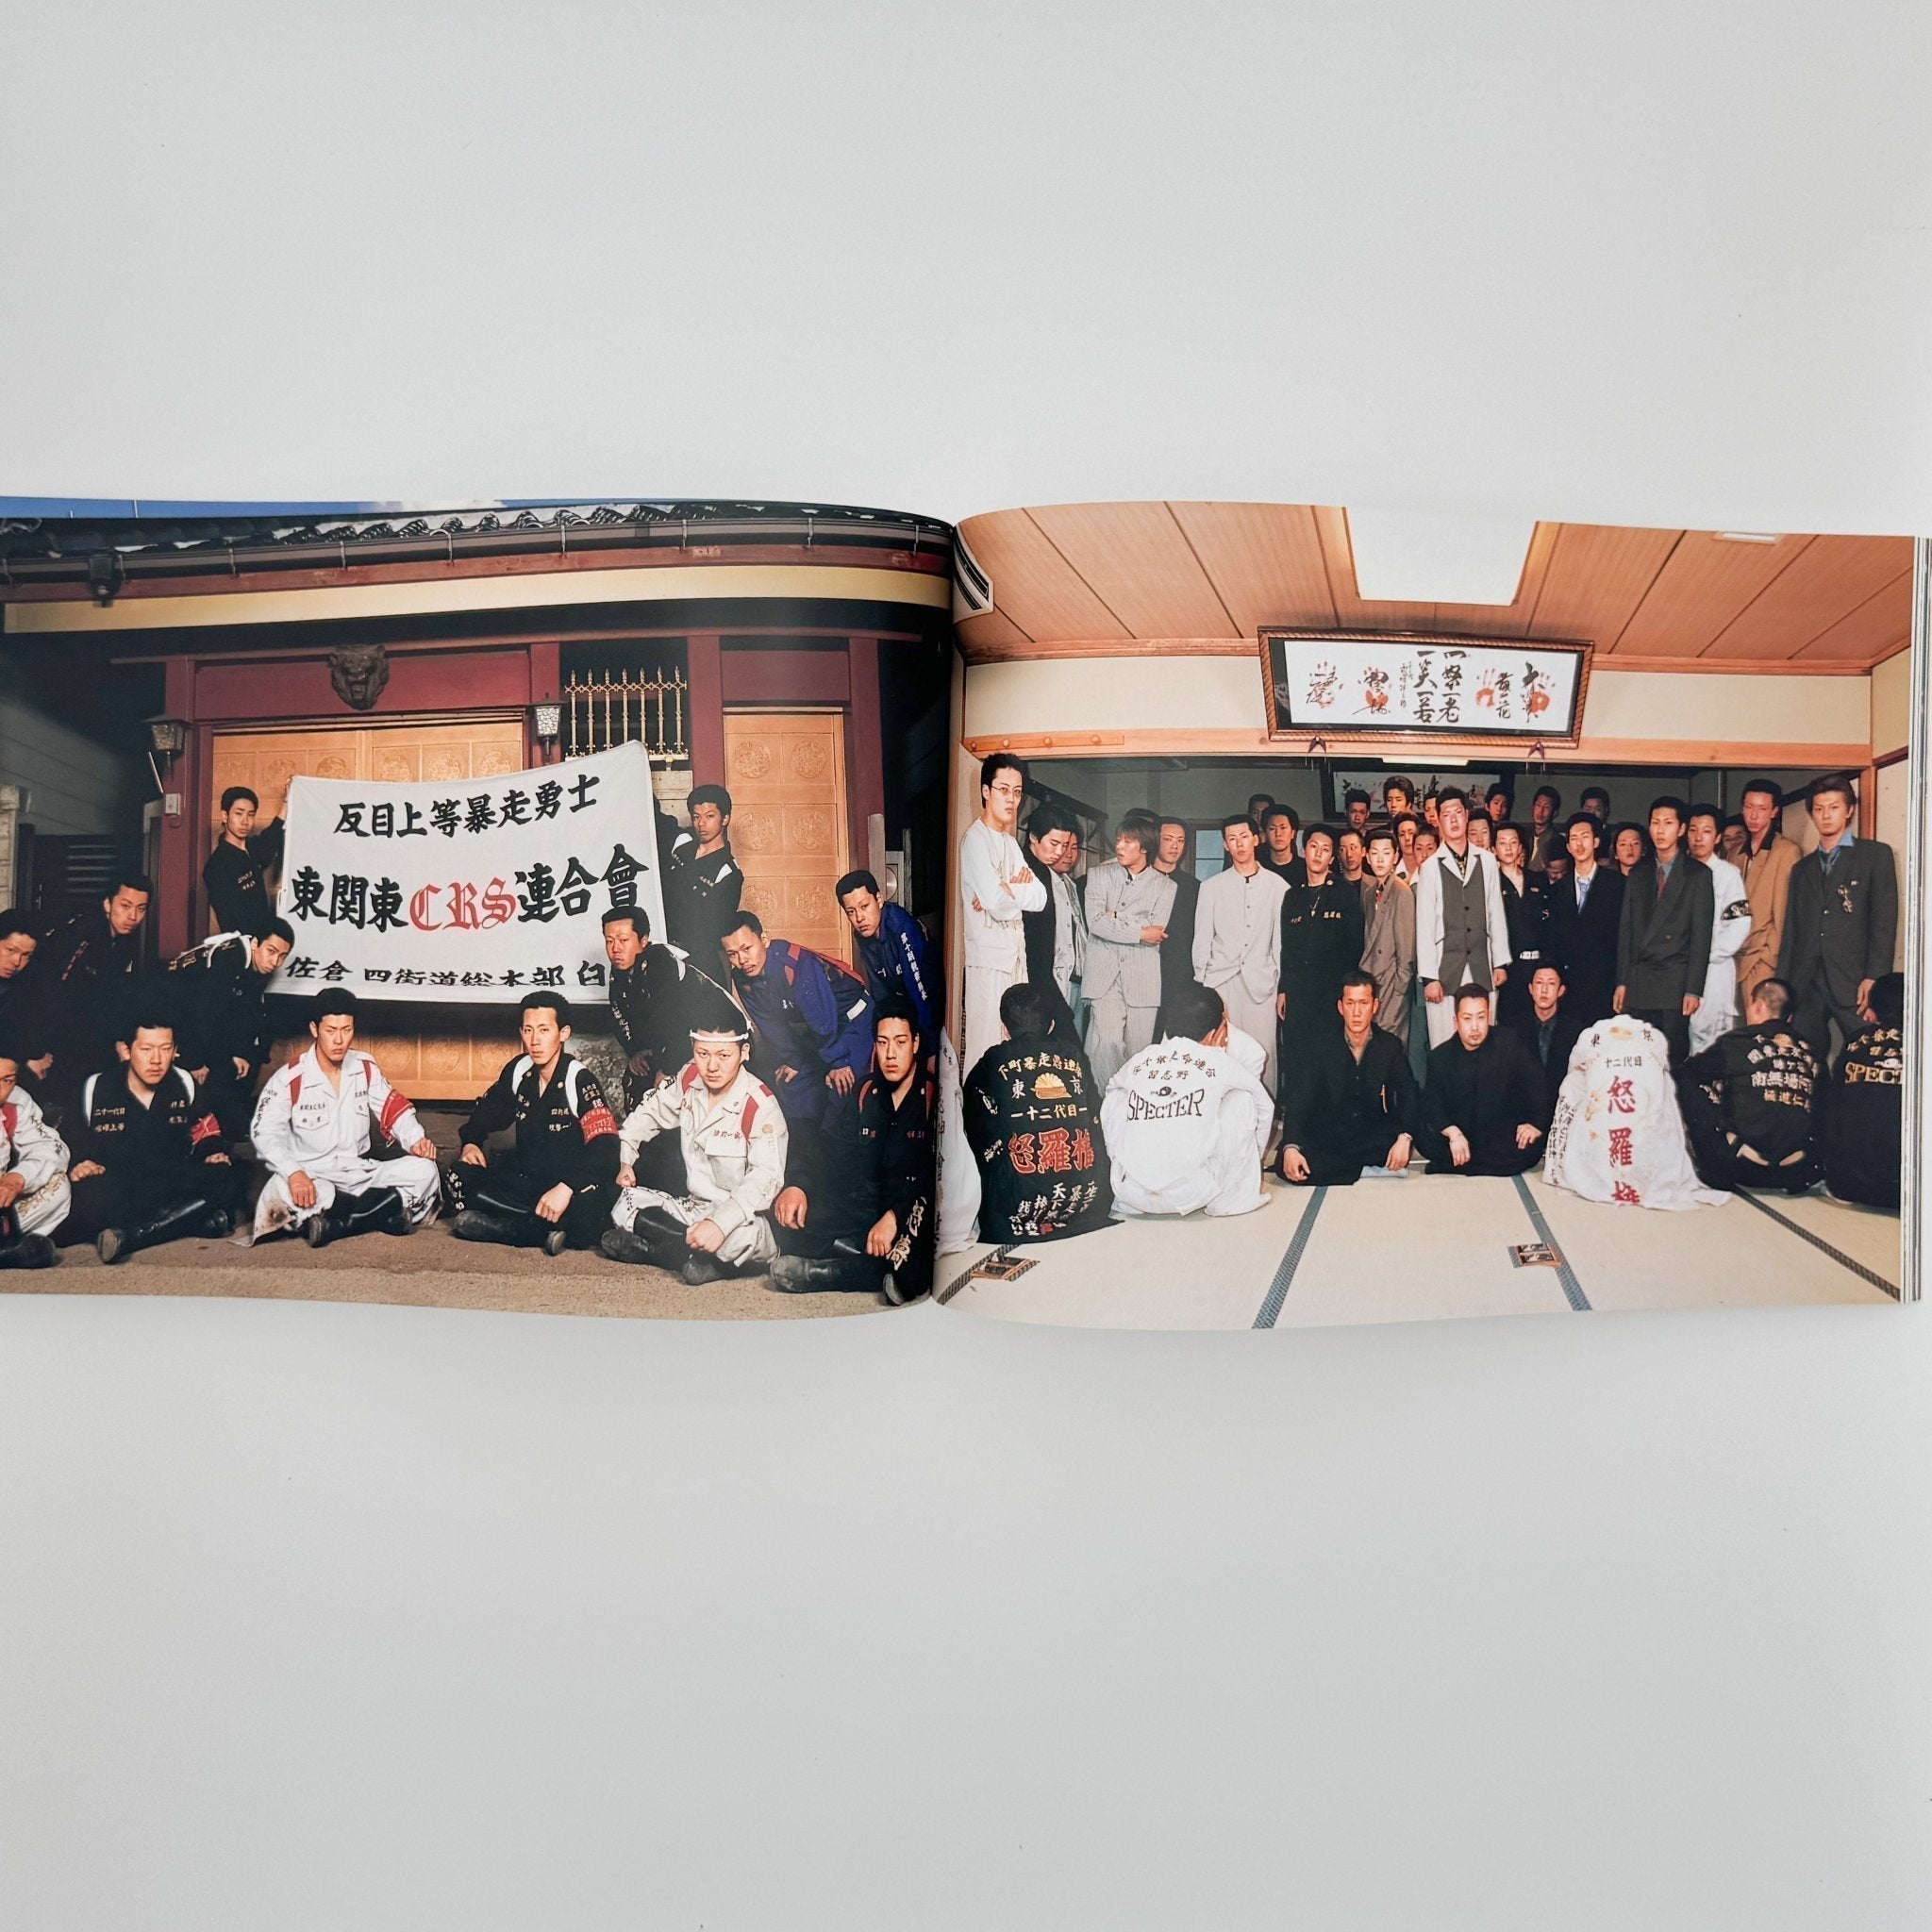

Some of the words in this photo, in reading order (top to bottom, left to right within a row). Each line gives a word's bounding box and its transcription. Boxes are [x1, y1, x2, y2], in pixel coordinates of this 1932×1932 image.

[334, 774, 600, 838] 反目上等暴走勇士
[1605, 1056, 1642, 1068] 十二代目
[1012, 1078, 1026, 1099] 東
[1070, 1075, 1084, 1094] 京
[1127, 1088, 1206, 1122] SPECTER
